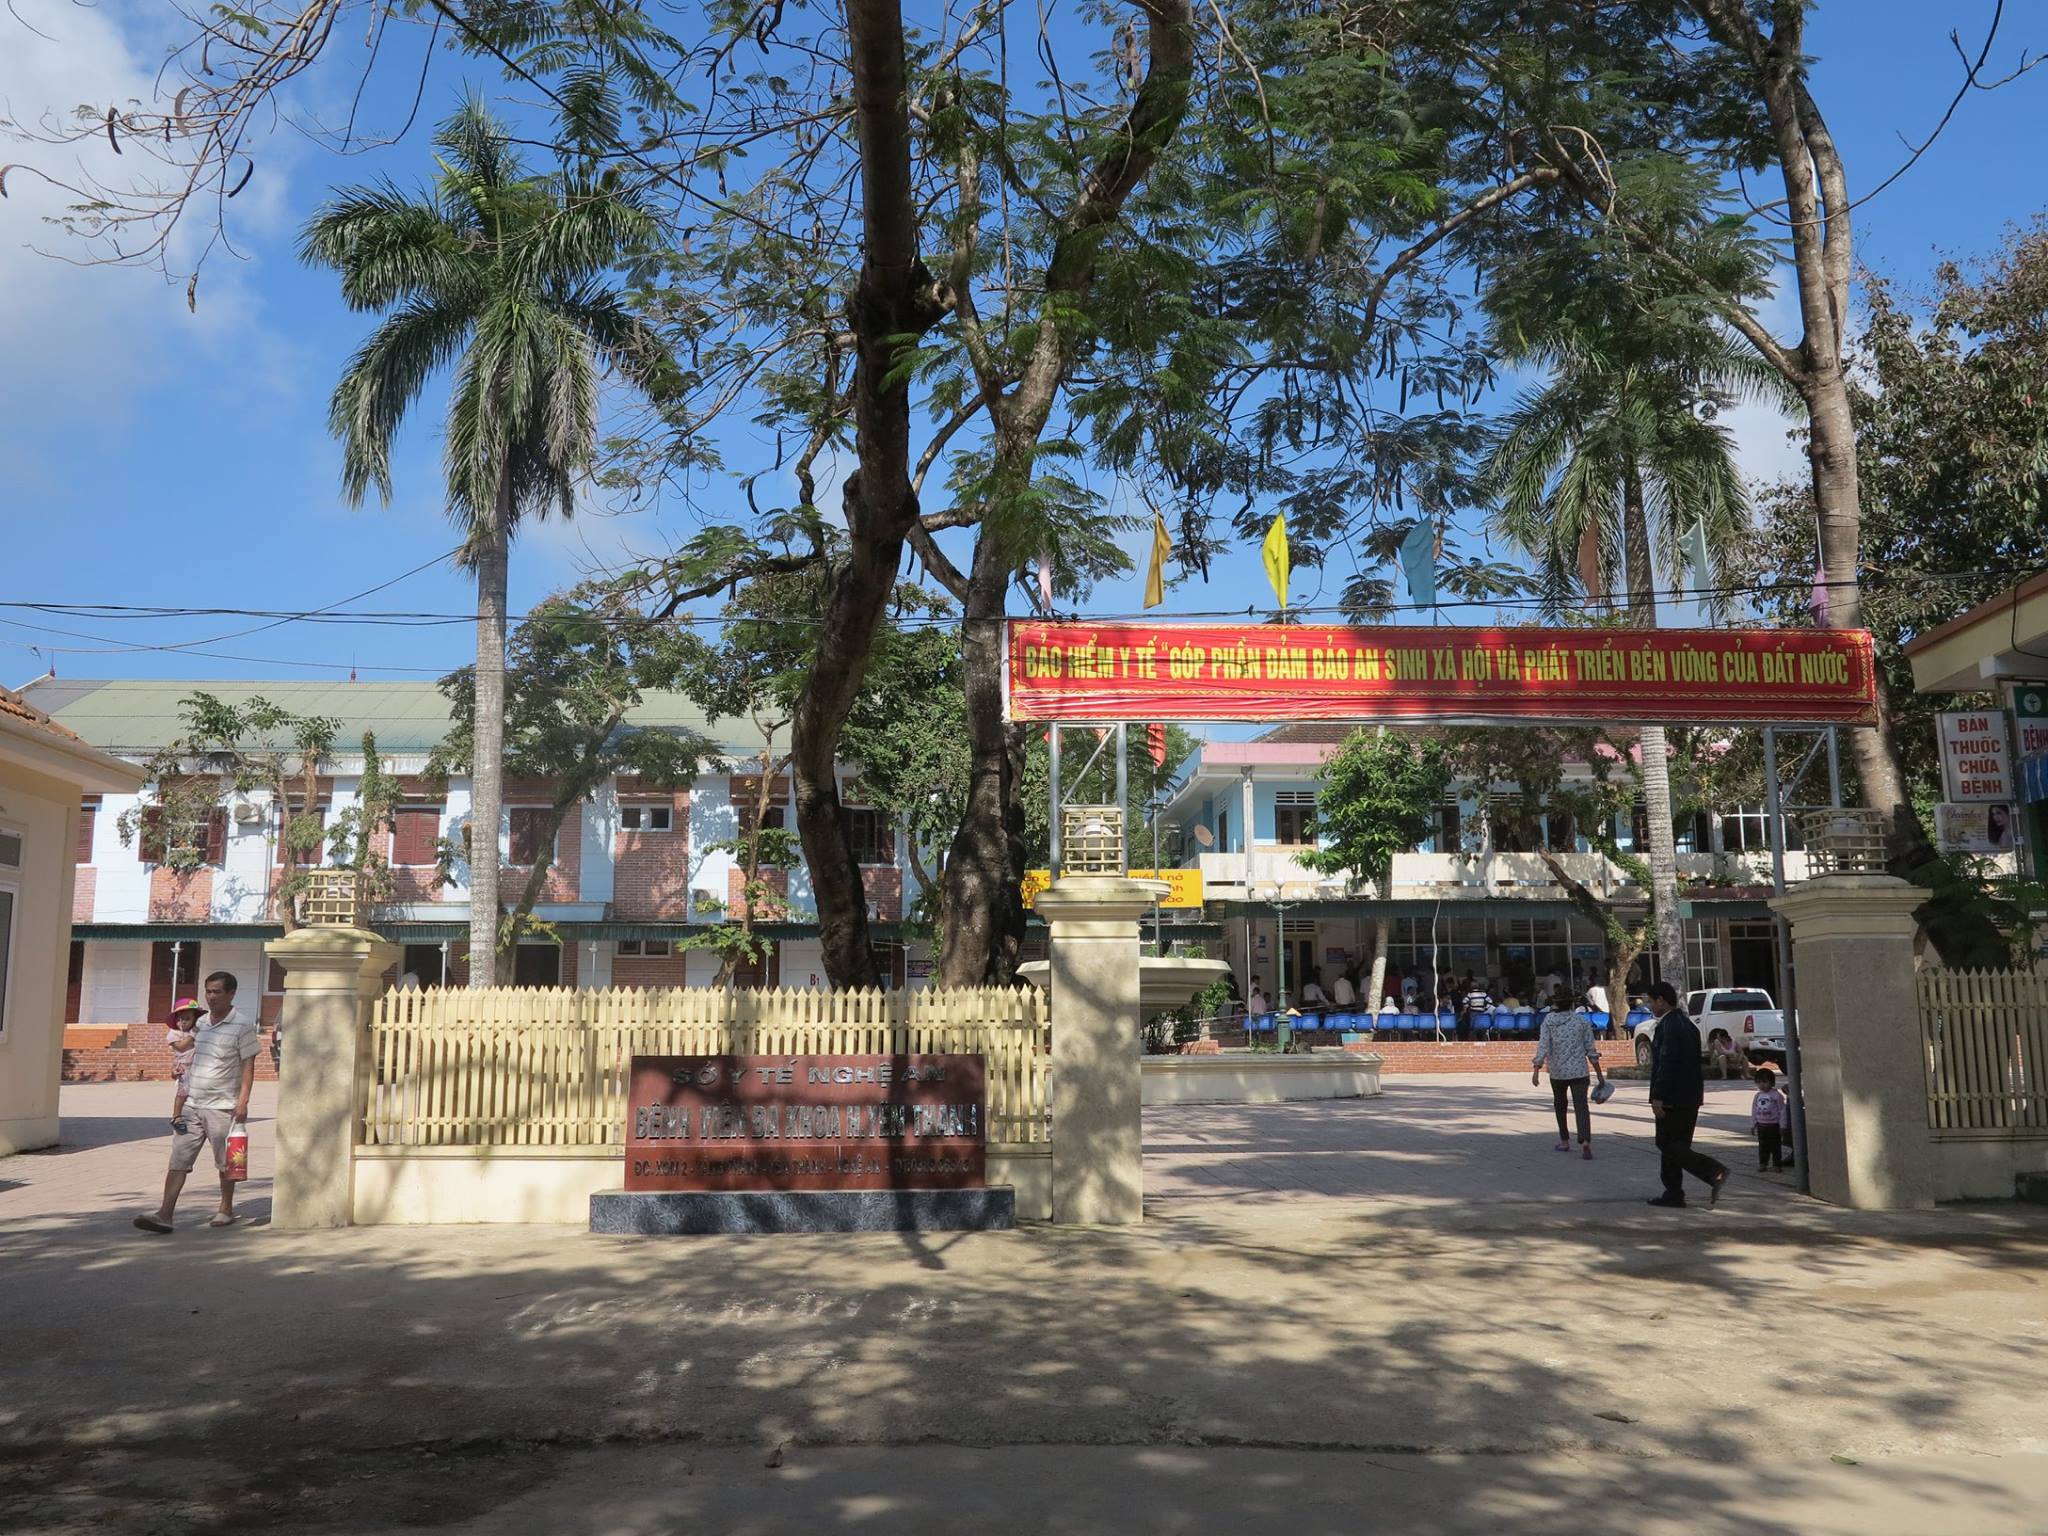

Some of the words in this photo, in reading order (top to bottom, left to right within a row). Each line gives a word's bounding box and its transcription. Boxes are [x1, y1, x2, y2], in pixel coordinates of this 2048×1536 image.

[1025, 632, 1062, 678] BẢO
[1067, 633, 1114, 678] HIỂM
[1119, 646, 1130, 678] Y
[1135, 635, 1157, 680] TẾ
[1212, 636, 1262, 680] PHẦN
[1265, 634, 1307, 680] ĐẢM
[1313, 634, 1349, 680] BẢO
[1354, 648, 1380, 680] AN
[1384, 648, 1428, 681] SINH
[1432, 641, 1458, 681] XÃ
[1461, 642, 1492, 688] HỘI
[1496, 642, 1521, 681] VÀ
[1524, 642, 1570, 681] PHÁT
[1574, 637, 1627, 682] TRIỂN
[1630, 638, 1666, 682] BỀN
[1670, 641, 1719, 683] VỮNG
[1723, 638, 1760, 683] CỦA
[1762, 640, 1795, 684] ĐẤT
[1958, 714, 1989, 733] BÁN
[1949, 735, 2001, 755] THUỐC
[1958, 754, 2000, 773] CHỮA
[1961, 776, 2002, 799] BỆNH
[726, 1067, 748, 1085] Y
[808, 1062, 894, 1088] NGHỆ
[899, 1064, 946, 1084] AN
[784, 1104, 842, 1140] KHOA
